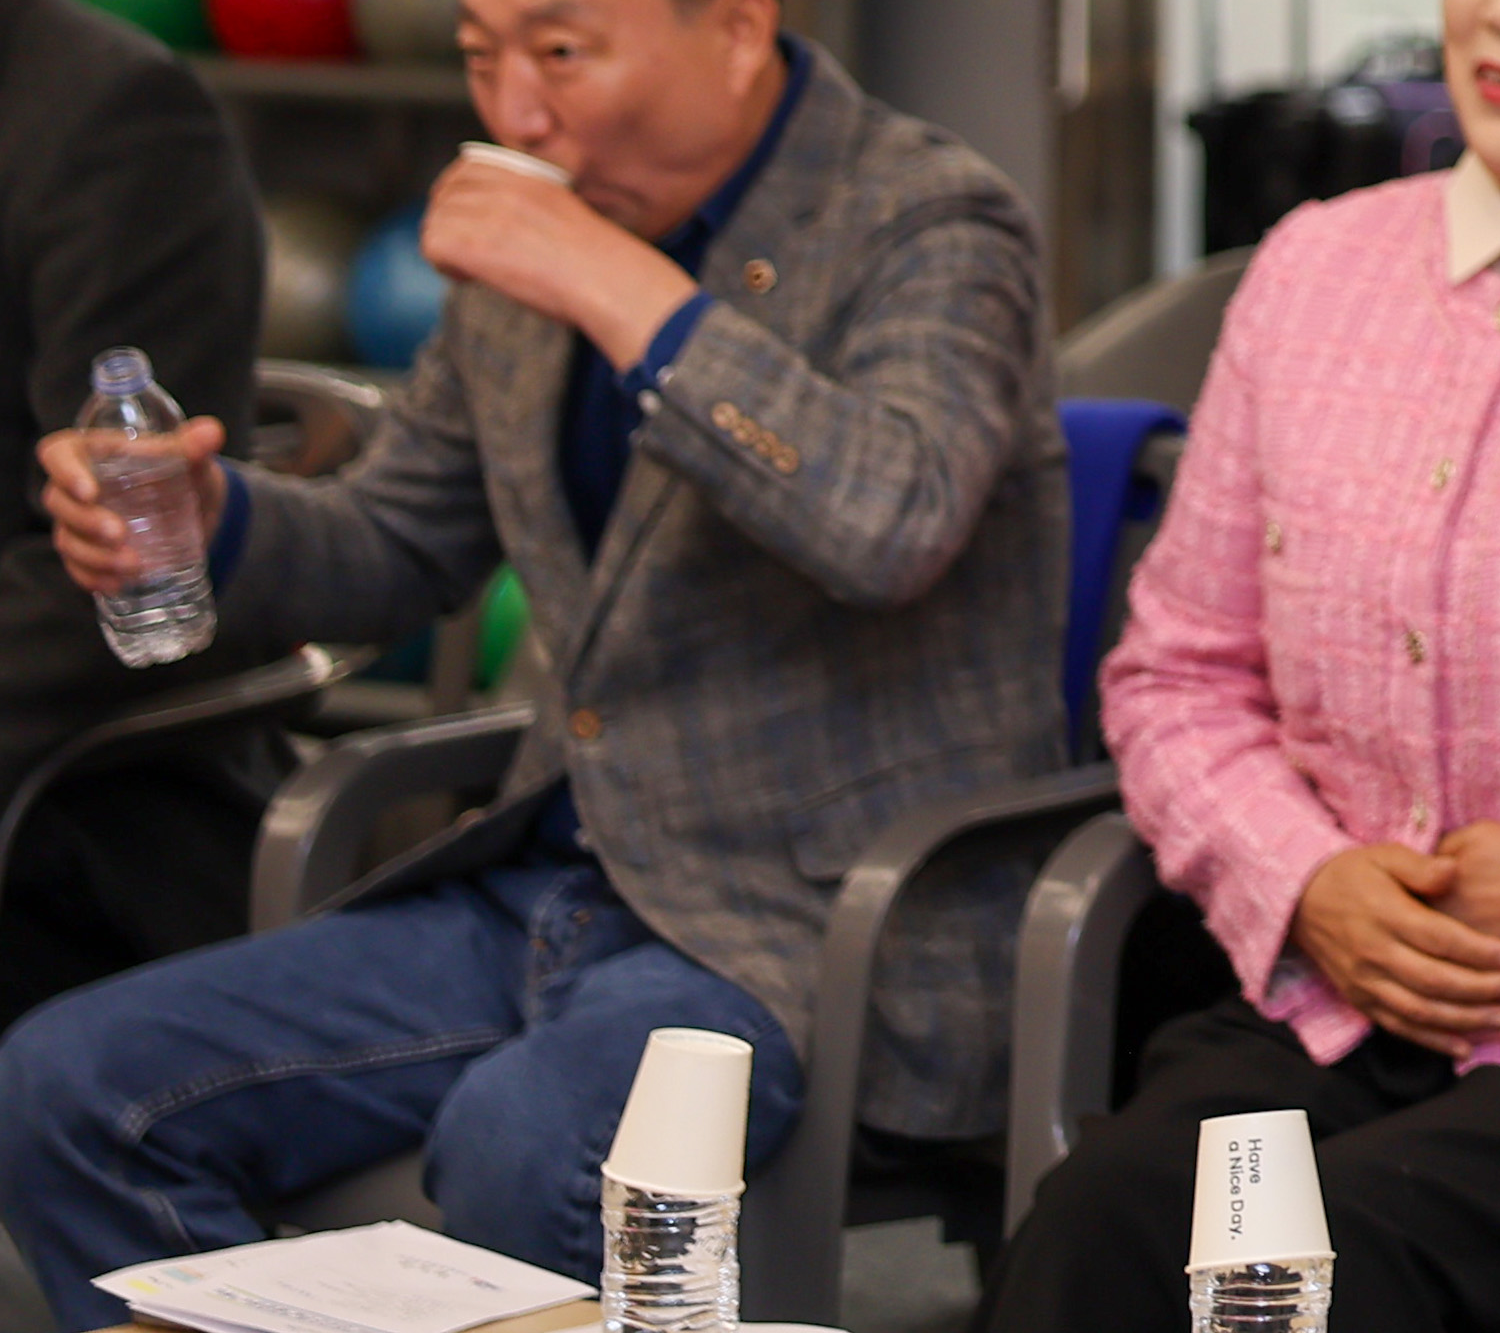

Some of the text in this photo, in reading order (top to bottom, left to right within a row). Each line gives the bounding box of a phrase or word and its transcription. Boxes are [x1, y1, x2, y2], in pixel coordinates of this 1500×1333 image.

[1228, 1140, 1244, 1240] a Nice Day.
[1248, 1138, 1263, 1184] Have
